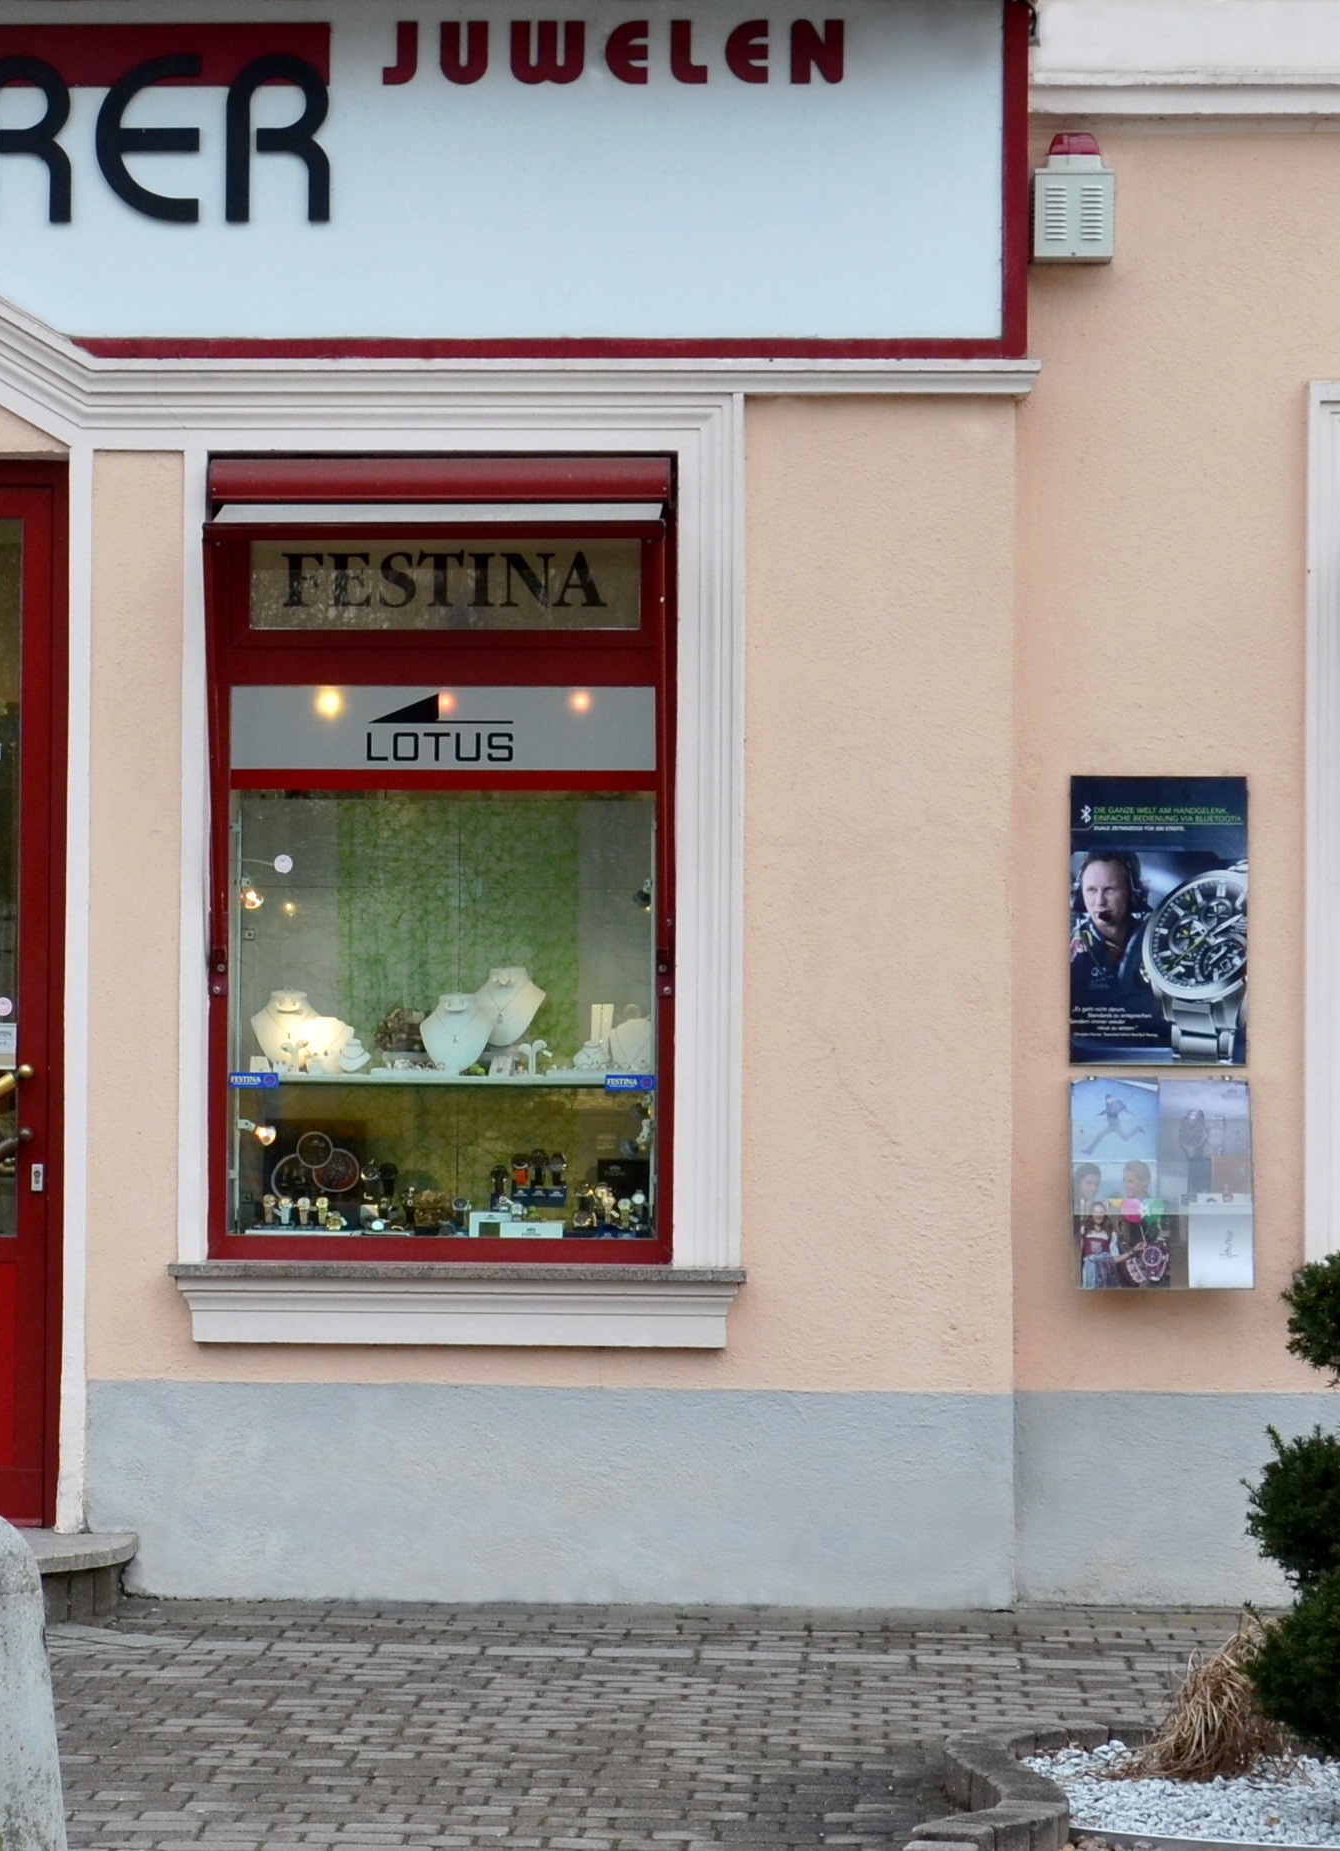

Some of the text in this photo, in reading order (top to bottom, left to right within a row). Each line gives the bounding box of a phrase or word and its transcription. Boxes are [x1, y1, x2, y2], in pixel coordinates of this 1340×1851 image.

[382, 20, 845, 85] JUWELEN
[281, 549, 608, 609] FESTINA
[366, 731, 514, 763] LOTUS
[1136, 806, 1157, 814] WELT
[230, 1075, 261, 1083] FESTINA
[607, 1077, 637, 1085] FESTINA
